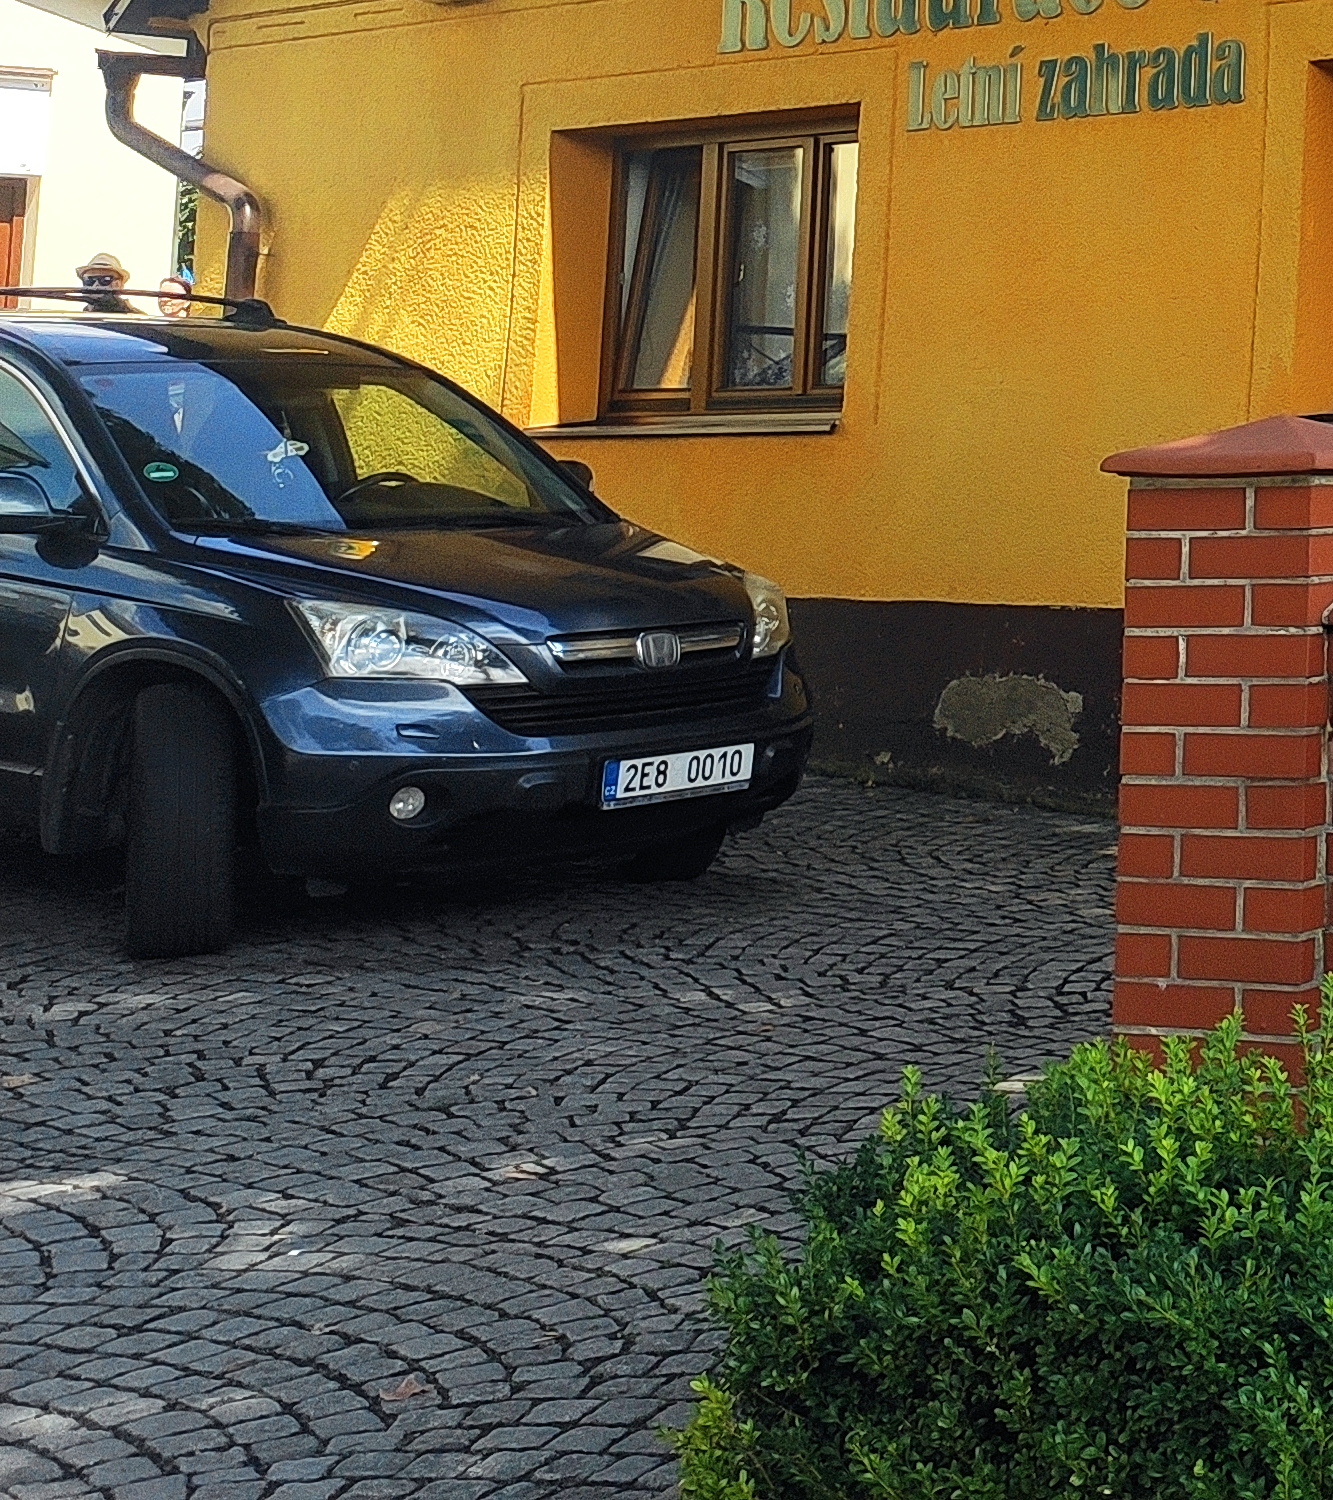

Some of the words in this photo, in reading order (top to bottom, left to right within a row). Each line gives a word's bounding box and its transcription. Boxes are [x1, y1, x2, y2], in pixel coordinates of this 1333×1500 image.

[906, 44, 1026, 132] Letní
[1035, 31, 1246, 122] zahrada
[604, 785, 616, 796] CZ
[622, 759, 669, 794] 2E8
[687, 749, 743, 784] 0010
